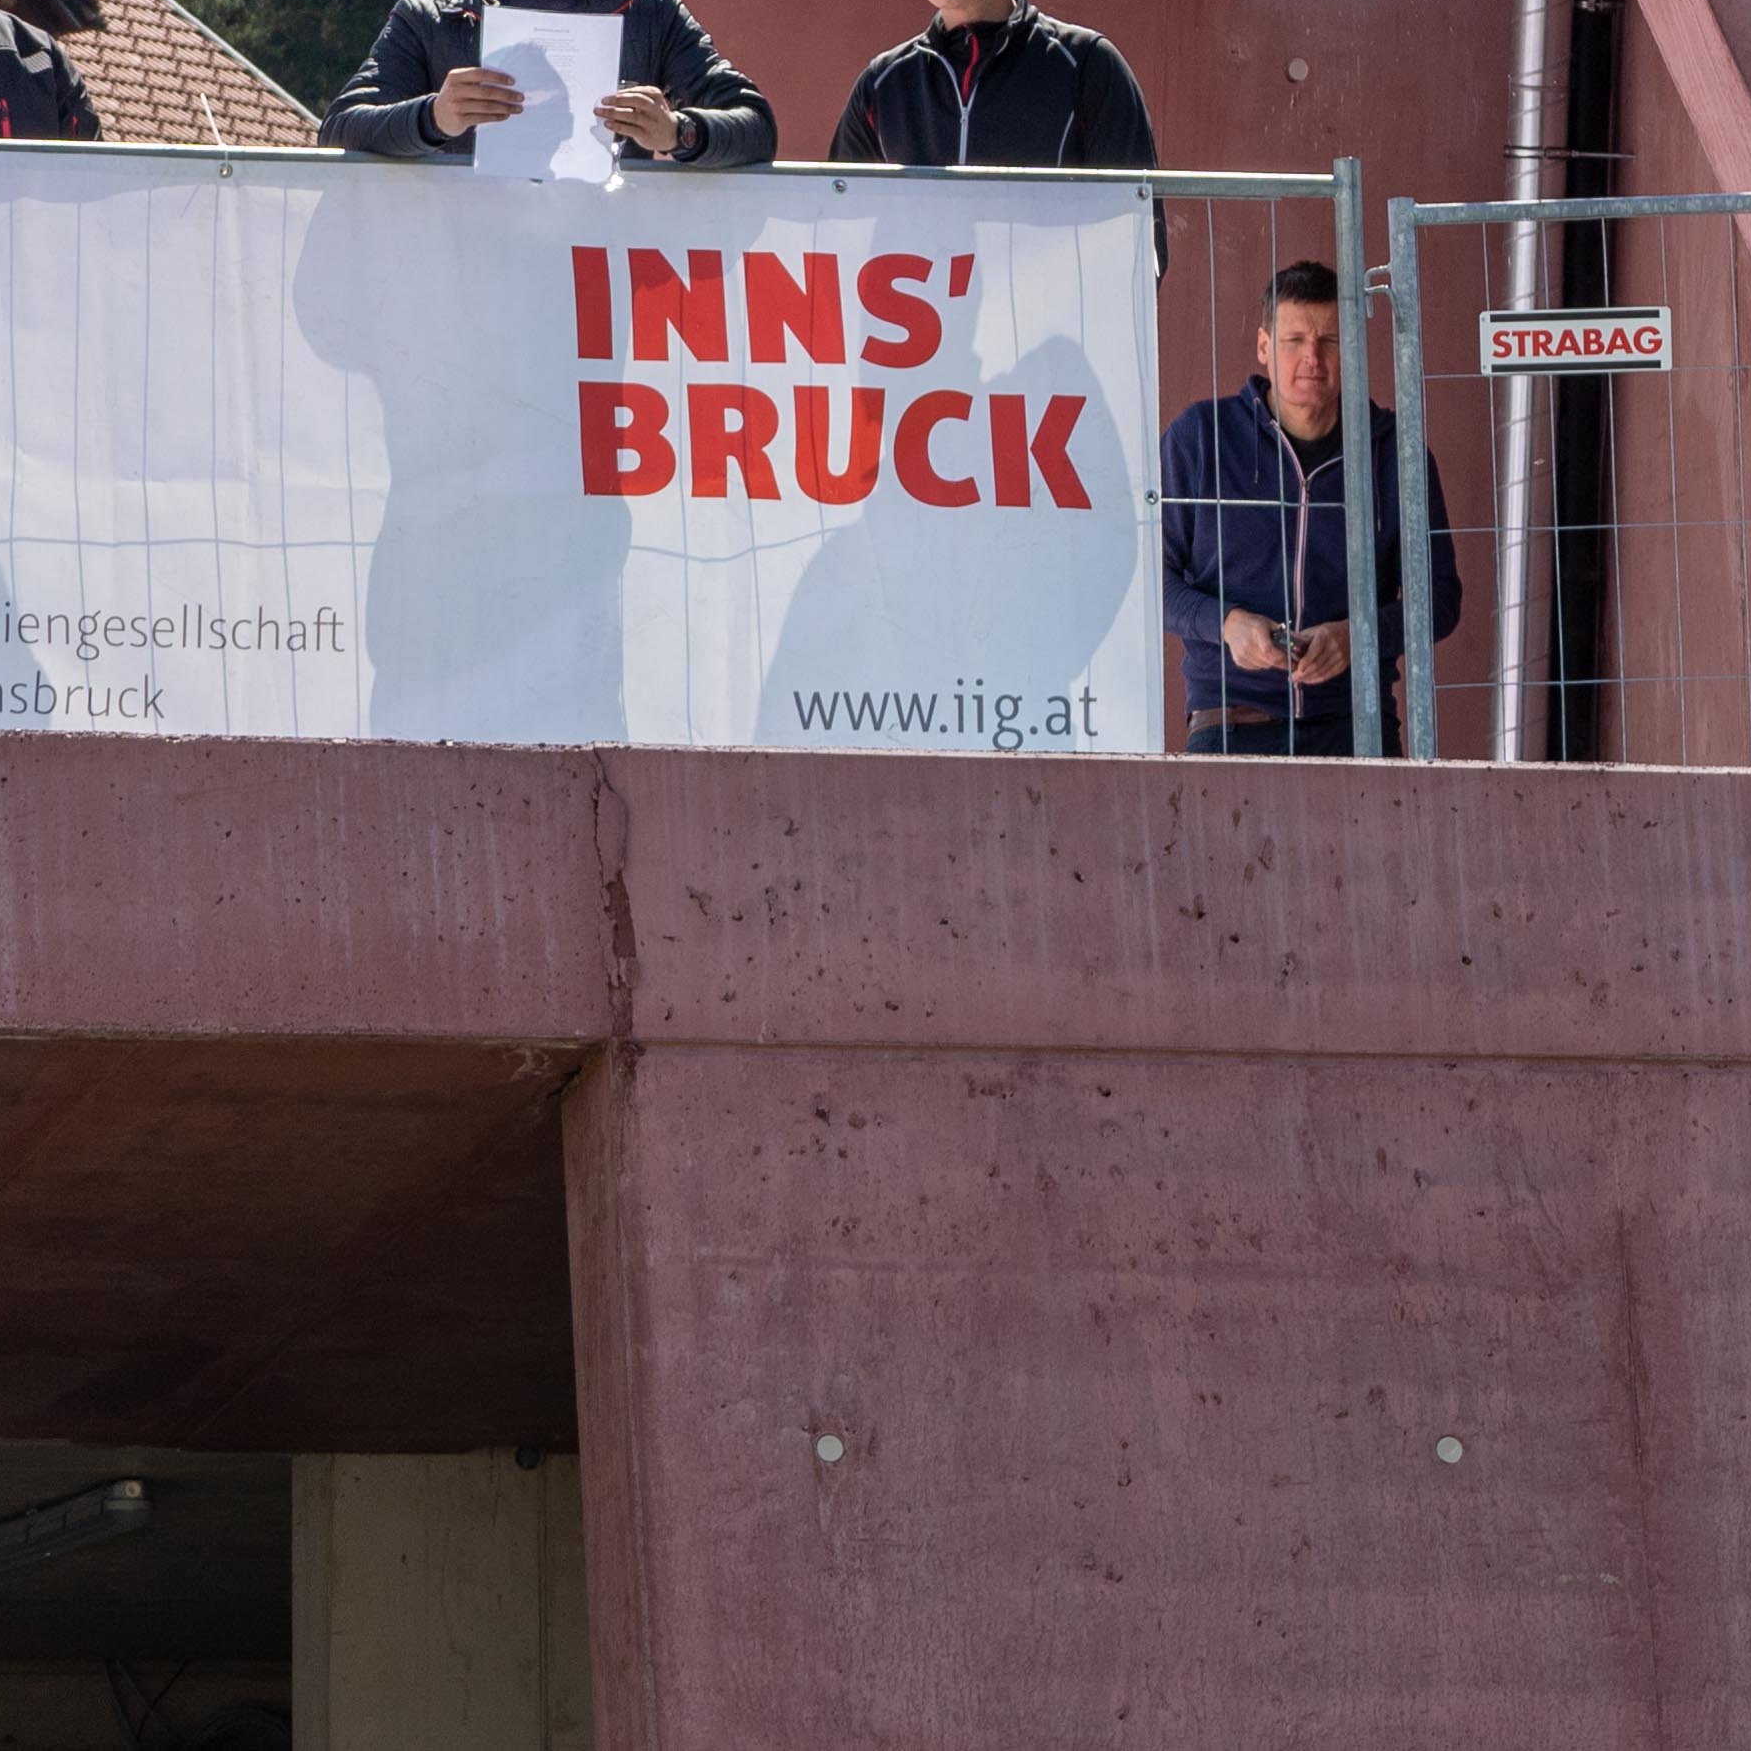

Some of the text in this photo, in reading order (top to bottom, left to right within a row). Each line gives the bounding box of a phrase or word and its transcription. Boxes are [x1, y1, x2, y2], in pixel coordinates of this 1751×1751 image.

[1491, 326, 1662, 358] STRABAG
[578, 381, 1092, 510] BRUCK
[793, 678, 1098, 753] www.iig.at
